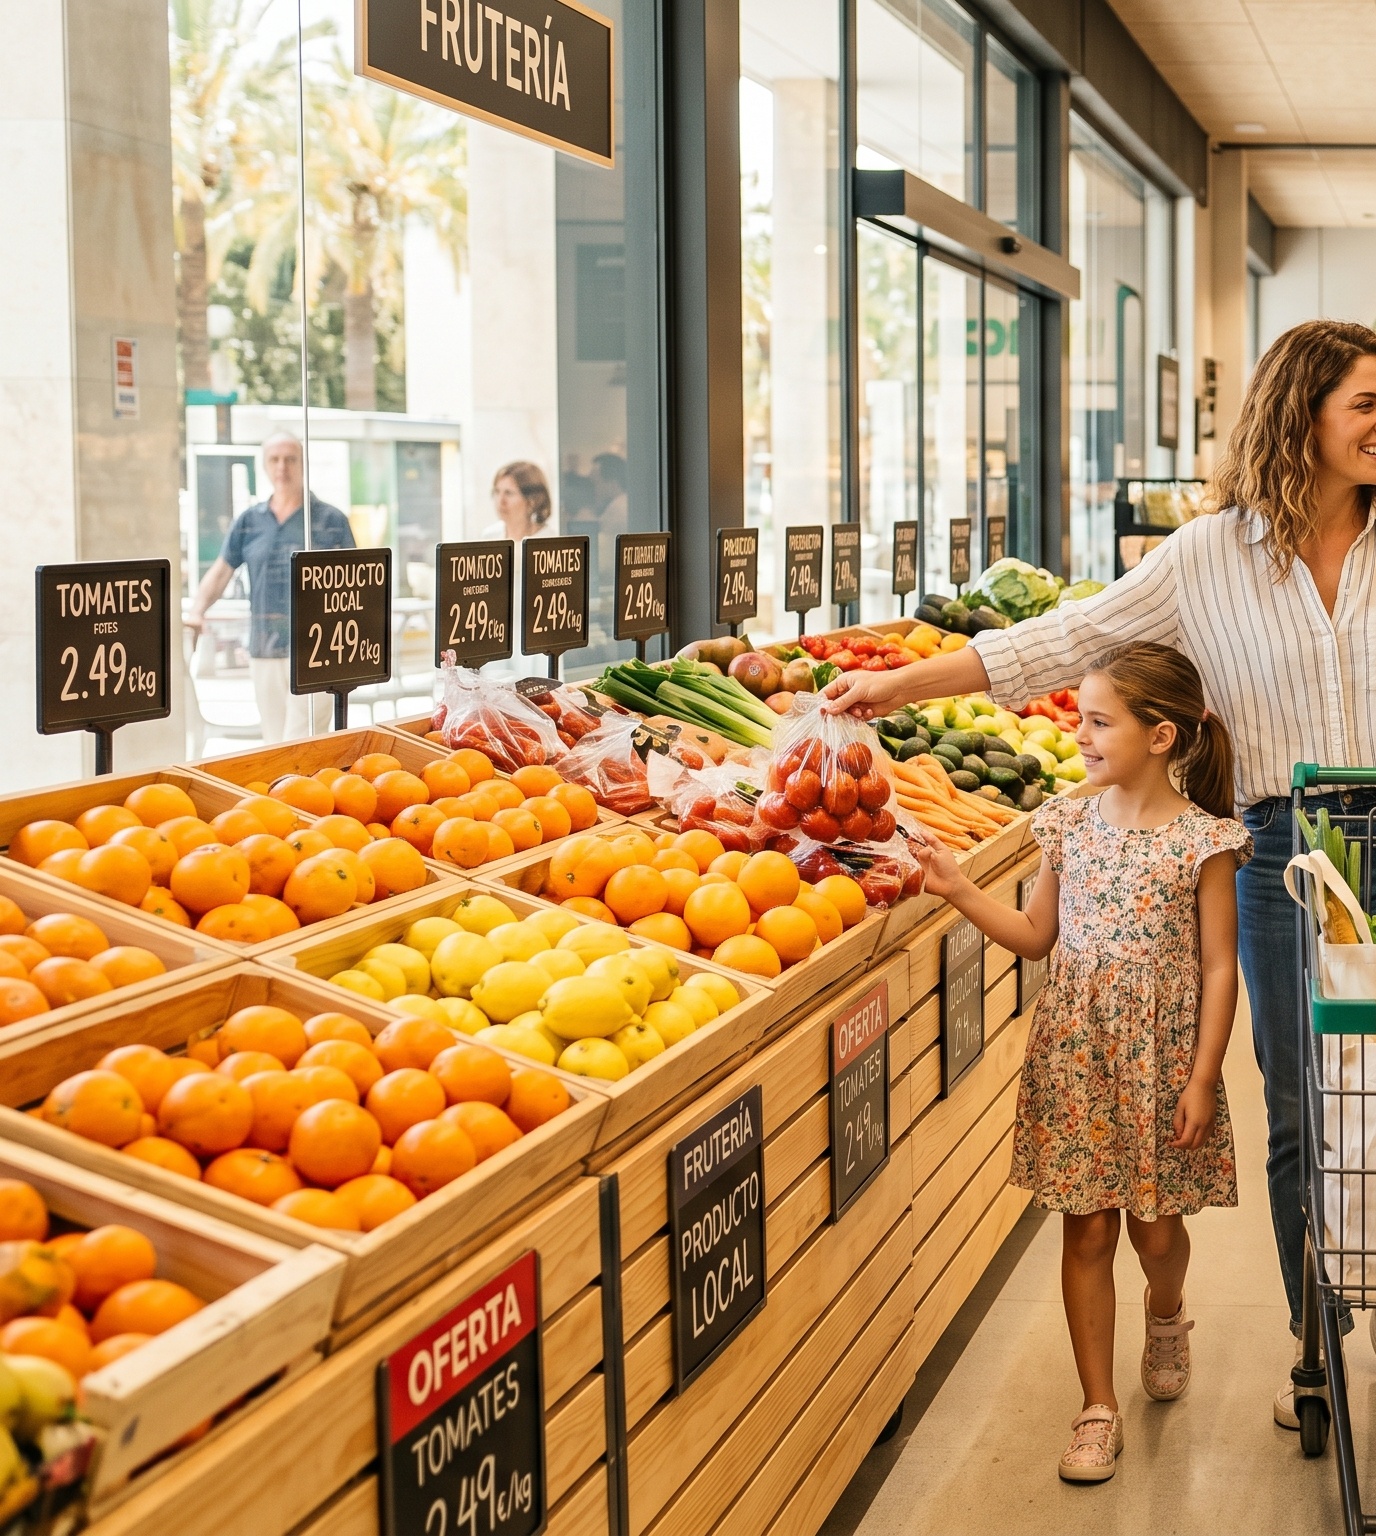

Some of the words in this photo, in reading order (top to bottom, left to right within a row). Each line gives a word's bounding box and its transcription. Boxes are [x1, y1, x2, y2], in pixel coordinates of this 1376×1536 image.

[421, 0, 571, 111] FRUTERÍA
[56, 579, 152, 618] TOMATES
[302, 563, 385, 591] PRODUCTO
[532, 548, 581, 575] TOMATES
[324, 590, 363, 614] LOCAL
[838, 995, 883, 1060] OFERTA
[839, 1048, 881, 1112] TOMATES
[683, 1100, 753, 1191] FRUTERÍA
[681, 1171, 759, 1272] PRODUCTO
[692, 1238, 754, 1339] LOCAL
[407, 1283, 522, 1406] OFERTA
[411, 1362, 520, 1487] TOMATES
